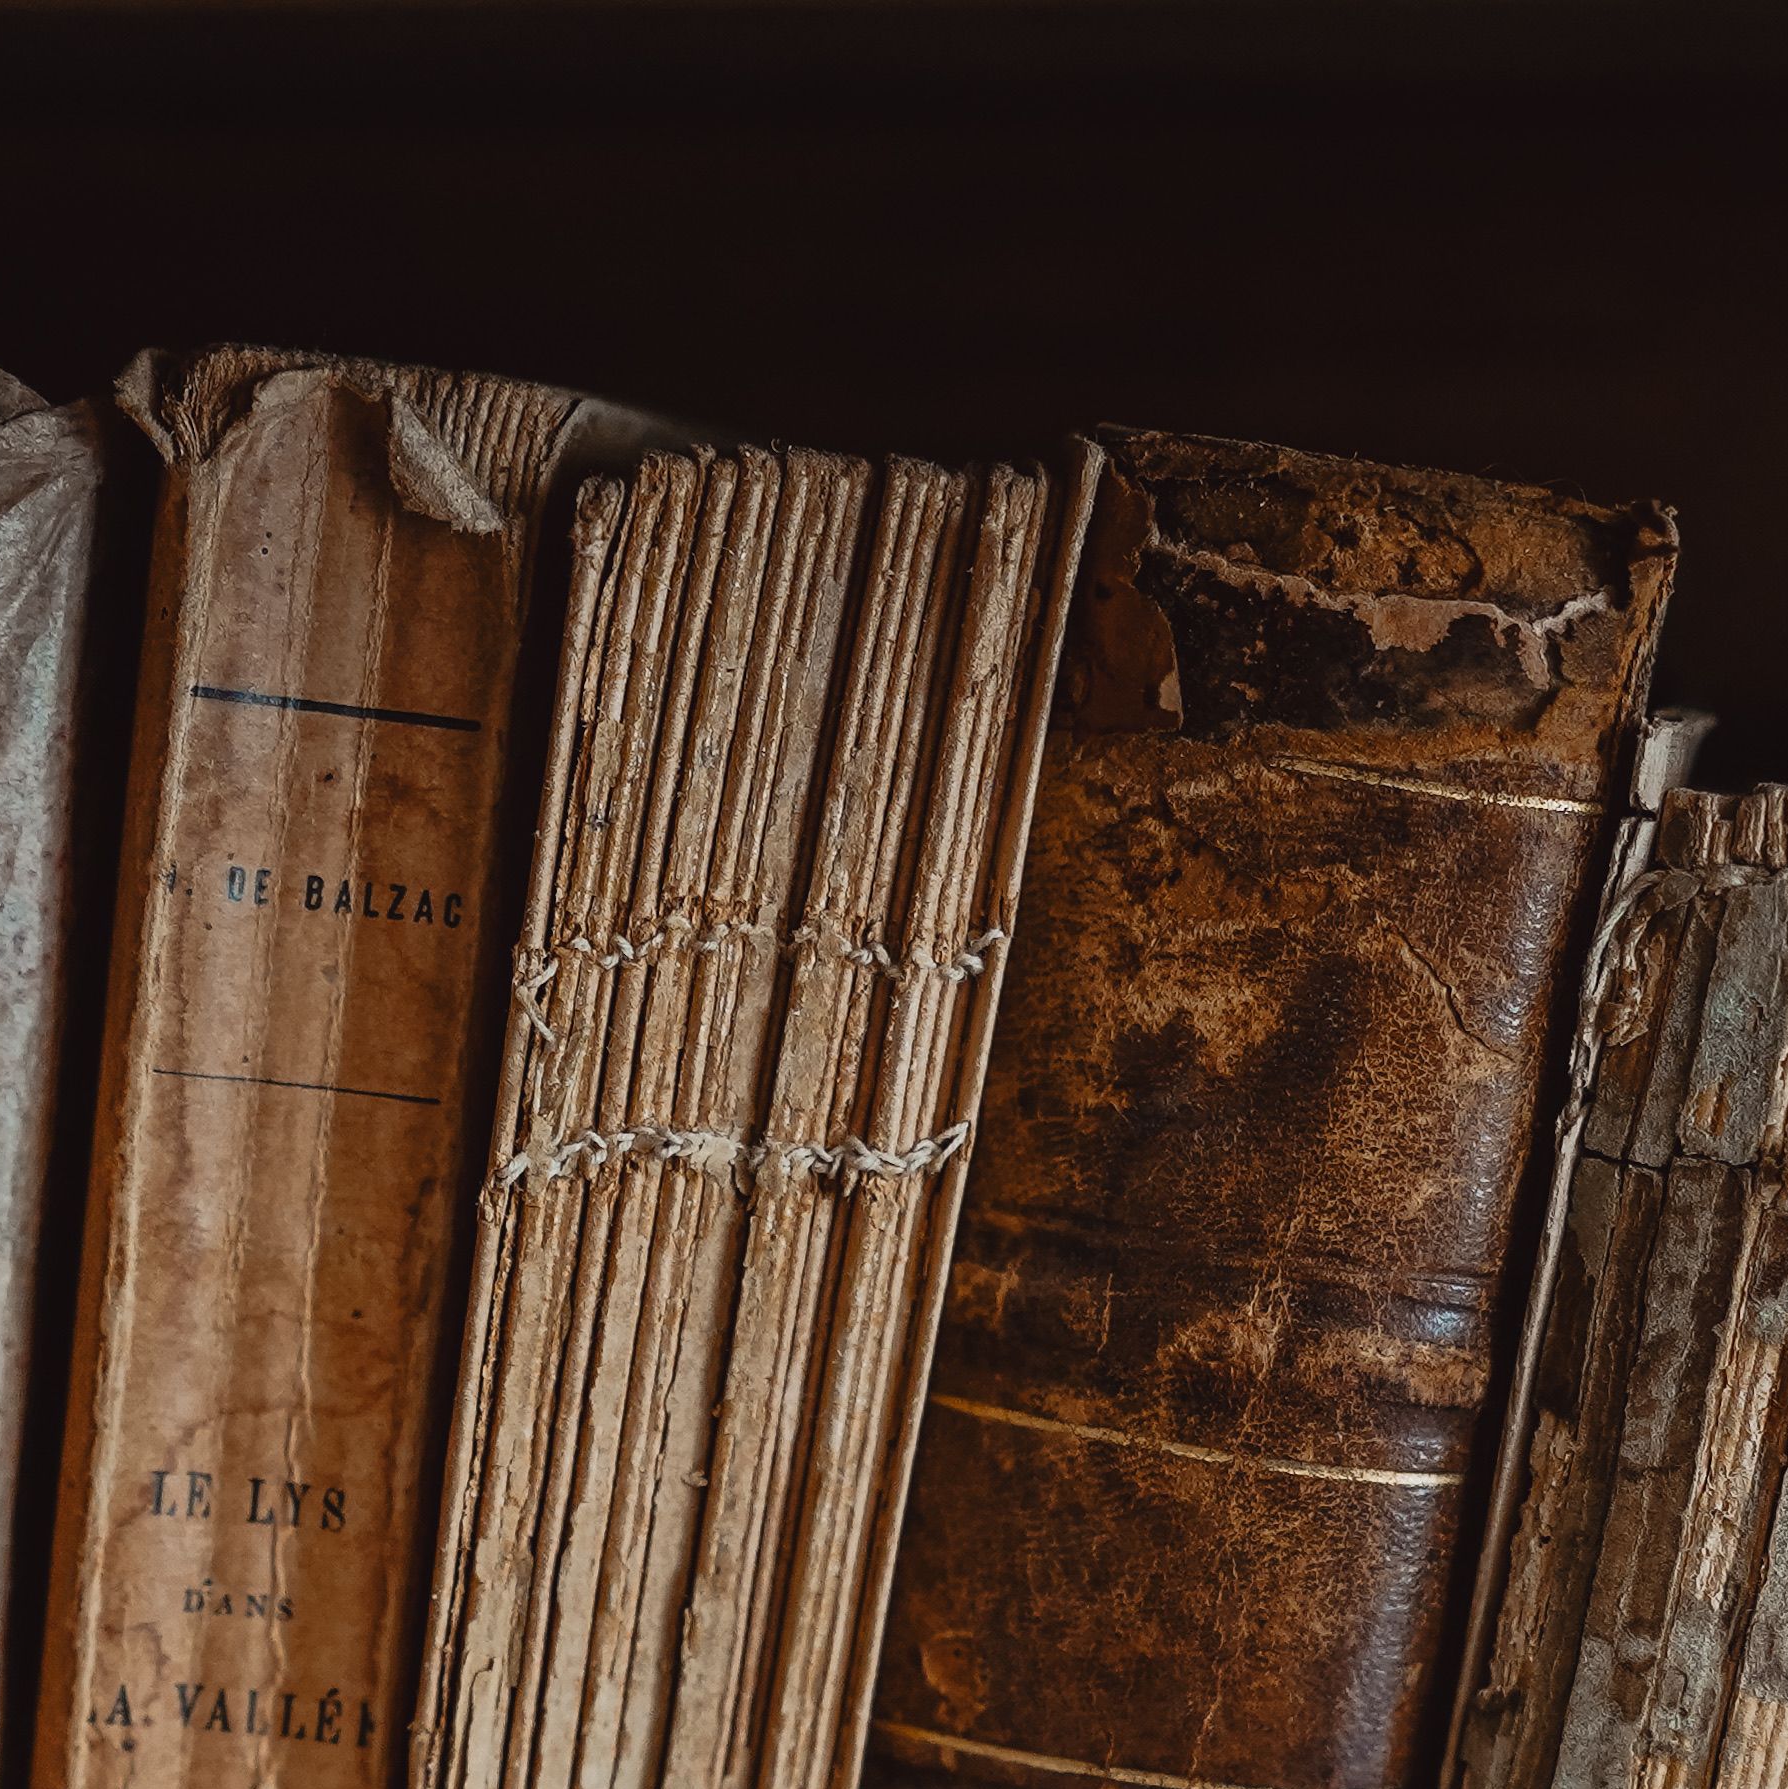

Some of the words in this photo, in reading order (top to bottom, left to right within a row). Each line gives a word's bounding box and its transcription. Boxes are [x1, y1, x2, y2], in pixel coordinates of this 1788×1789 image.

[227, 866, 272, 905] DE
[304, 874, 463, 929] BALZAC
[150, 1470, 213, 1519] LE
[247, 1477, 347, 1533] LYS
[182, 1586, 295, 1622] DANS
